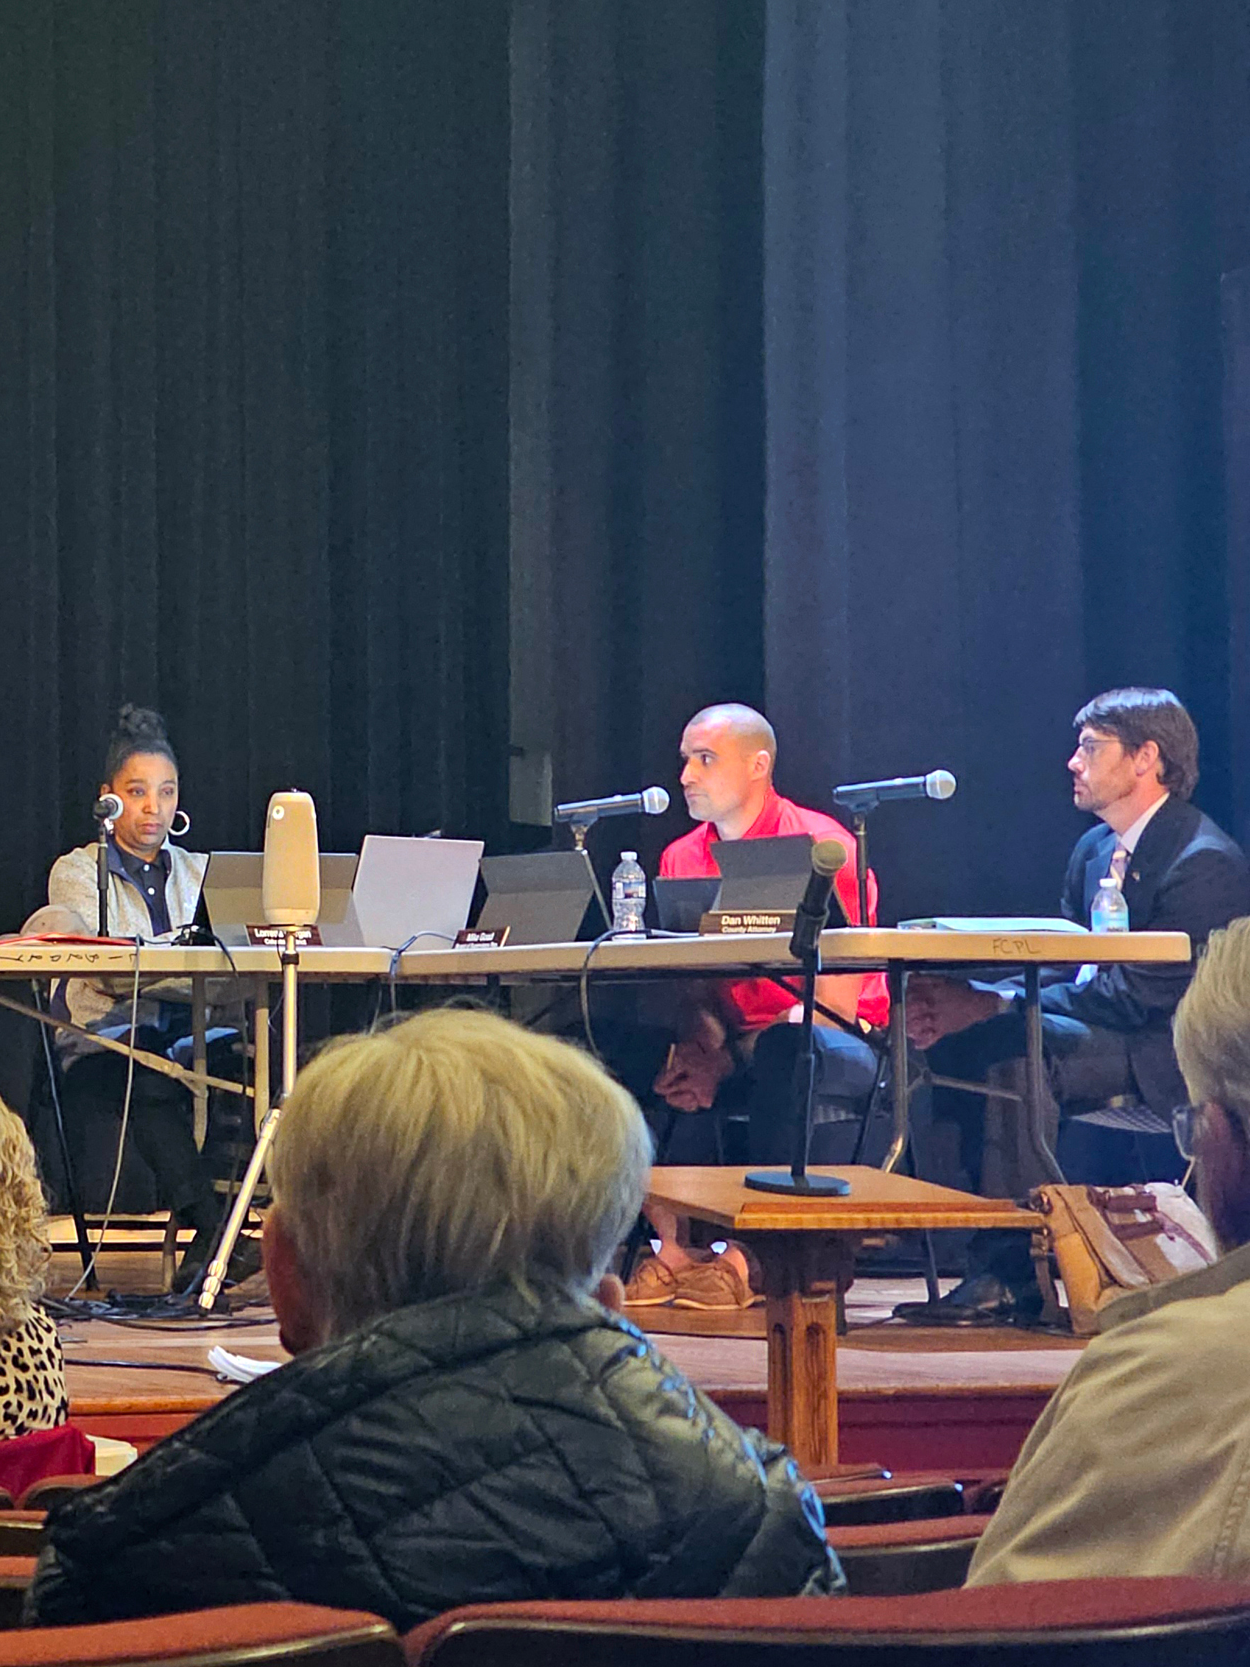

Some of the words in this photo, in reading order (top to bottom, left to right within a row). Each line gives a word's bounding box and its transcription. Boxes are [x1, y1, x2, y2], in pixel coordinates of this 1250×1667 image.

[721, 915, 741, 925] Dan
[743, 915, 781, 925] Whitten
[721, 926, 746, 934] County
